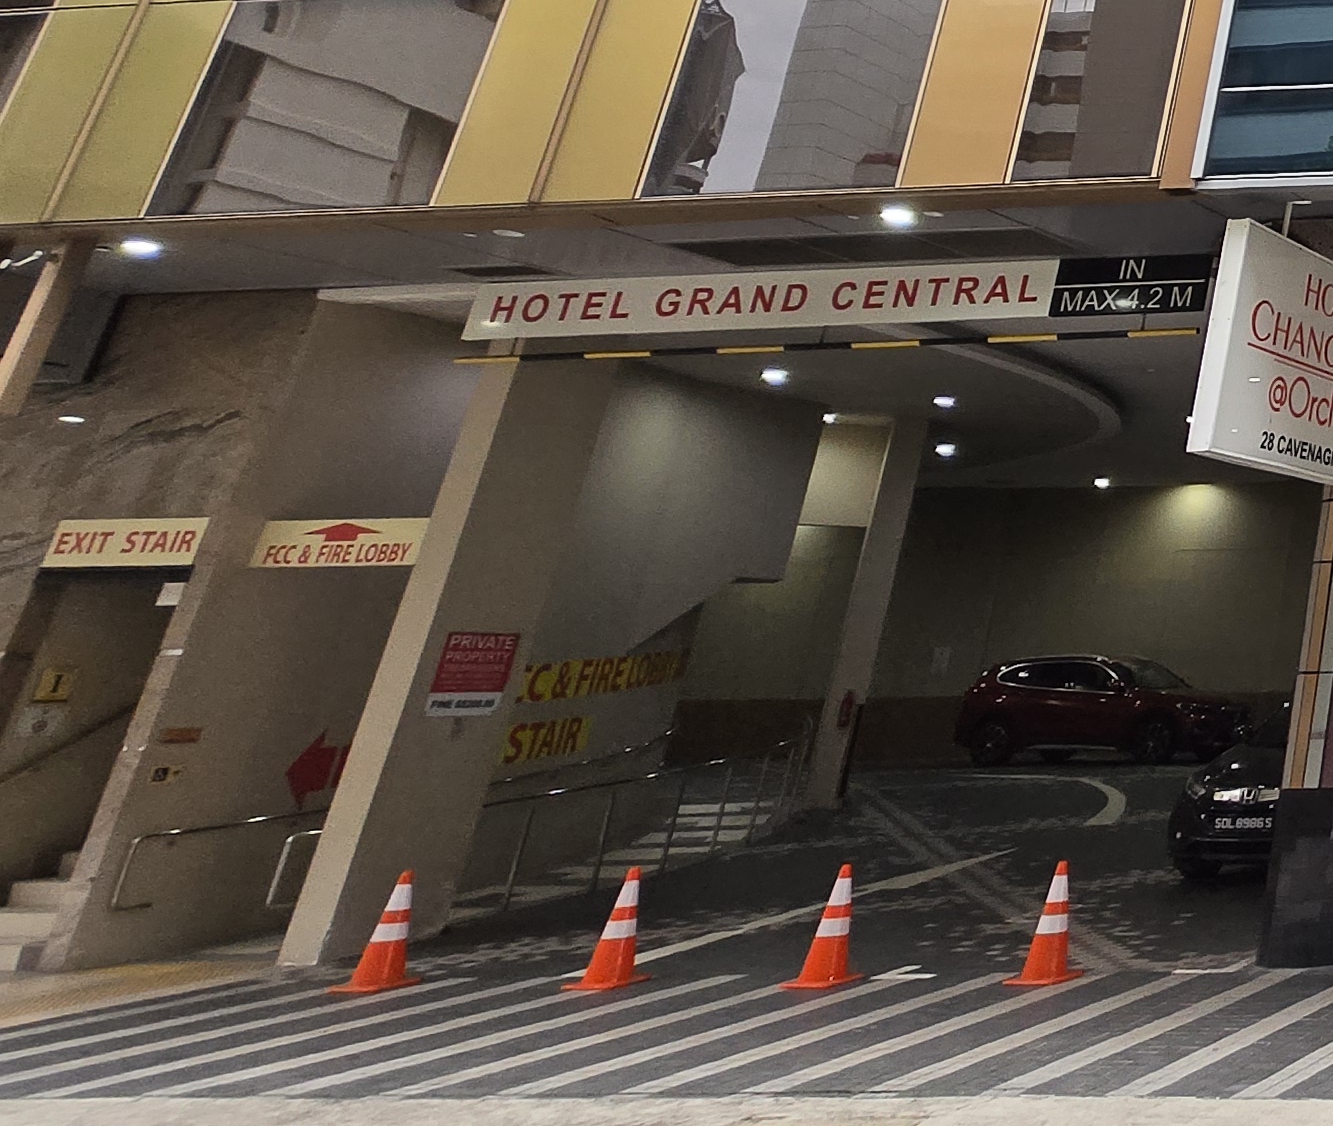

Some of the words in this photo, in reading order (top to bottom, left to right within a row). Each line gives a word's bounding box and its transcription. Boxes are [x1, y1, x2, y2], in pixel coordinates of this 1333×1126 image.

[1118, 259, 1146, 280] IN
[490, 290, 630, 323] HOTEL
[655, 283, 809, 318] GRAND
[831, 274, 1037, 312] CENTRAL
[1060, 288, 1121, 312] MAX
[1125, 287, 1163, 310] 4.2
[1169, 285, 1193, 308] M
[1260, 430, 1275, 452] 28
[52, 530, 116, 556] EXIT
[121, 529, 198, 555] STAIR
[260, 545, 293, 565] FCC
[296, 544, 311, 564] &
[315, 543, 352, 564] FIRE
[354, 542, 414, 564] LOBBY
[449, 634, 516, 650] PRIVATE
[445, 650, 511, 662] PROPERTY
[573, 656, 627, 697] FIRE
[502, 717, 586, 764] STAIR
